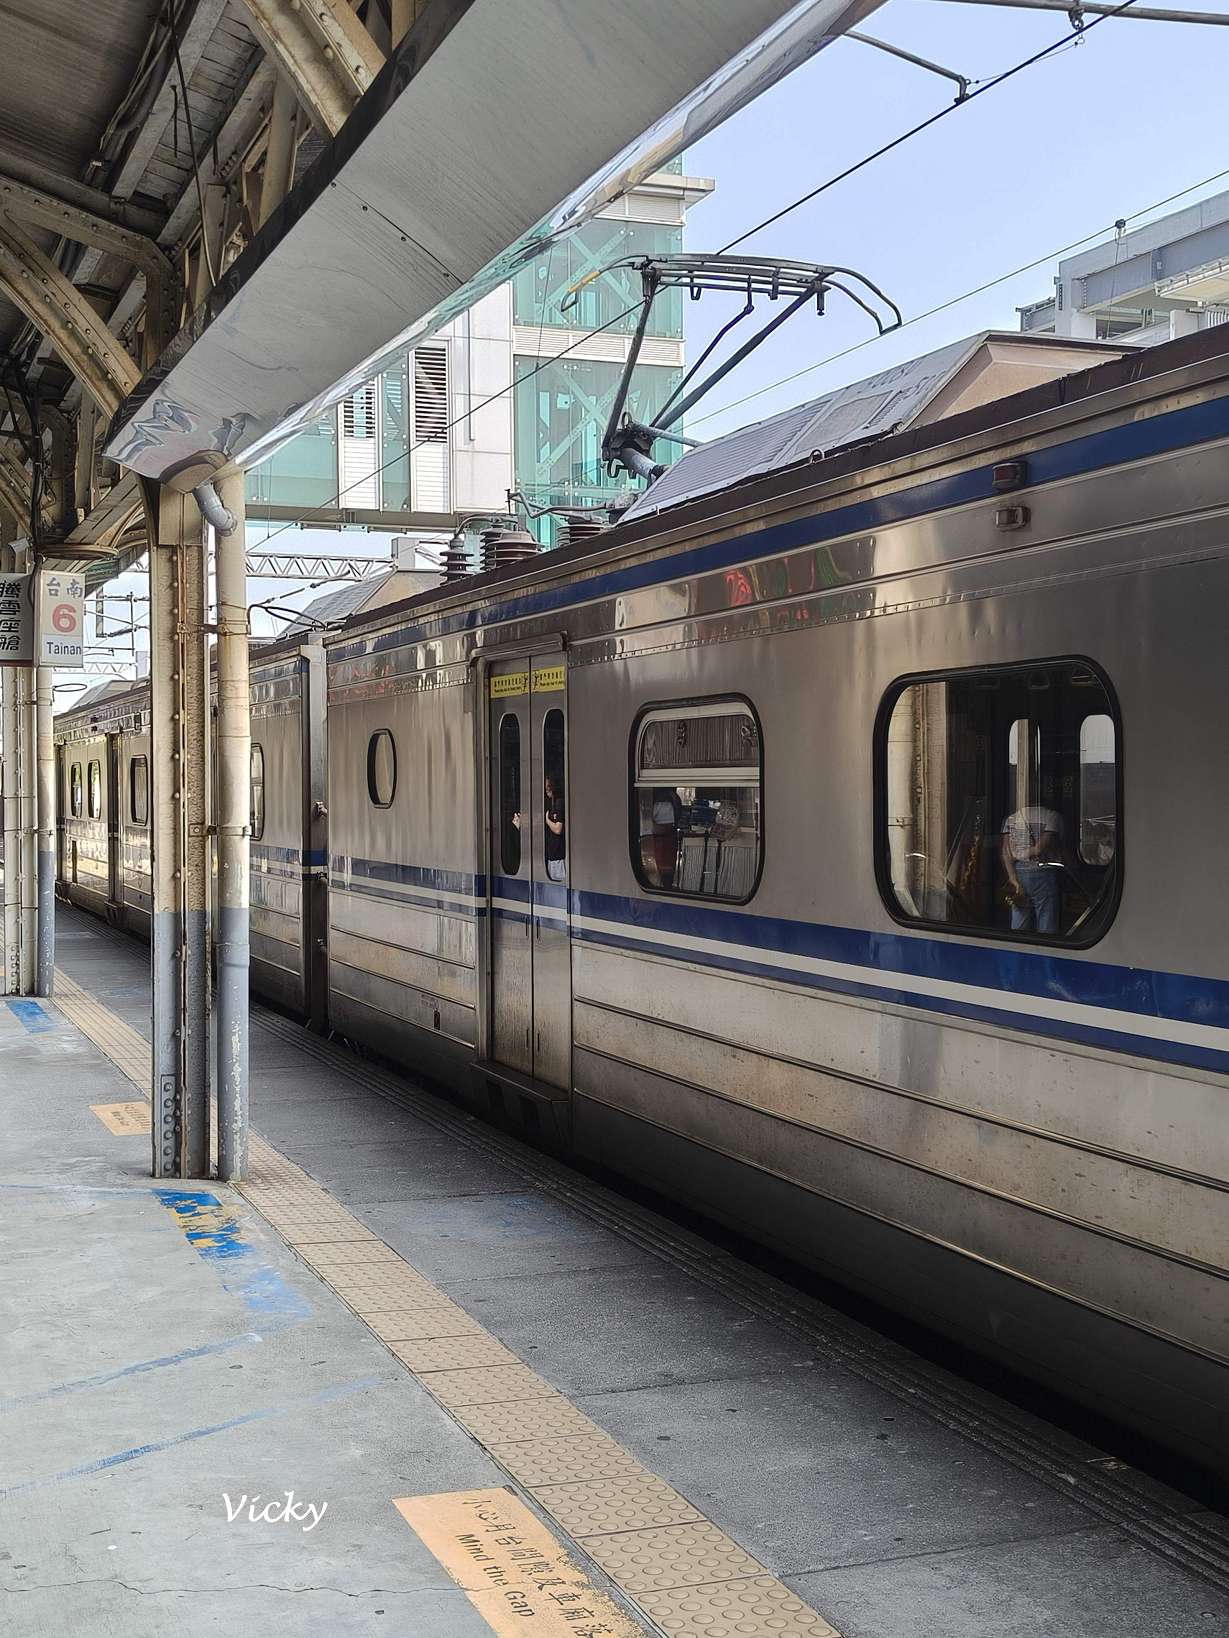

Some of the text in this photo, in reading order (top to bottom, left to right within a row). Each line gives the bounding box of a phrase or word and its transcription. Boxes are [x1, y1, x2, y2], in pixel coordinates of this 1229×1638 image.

[46, 577, 83, 599] 台南
[52, 603, 77, 633] 6
[46, 641, 82, 656] Tainan
[455, 1533, 536, 1618] Mind the Gap
